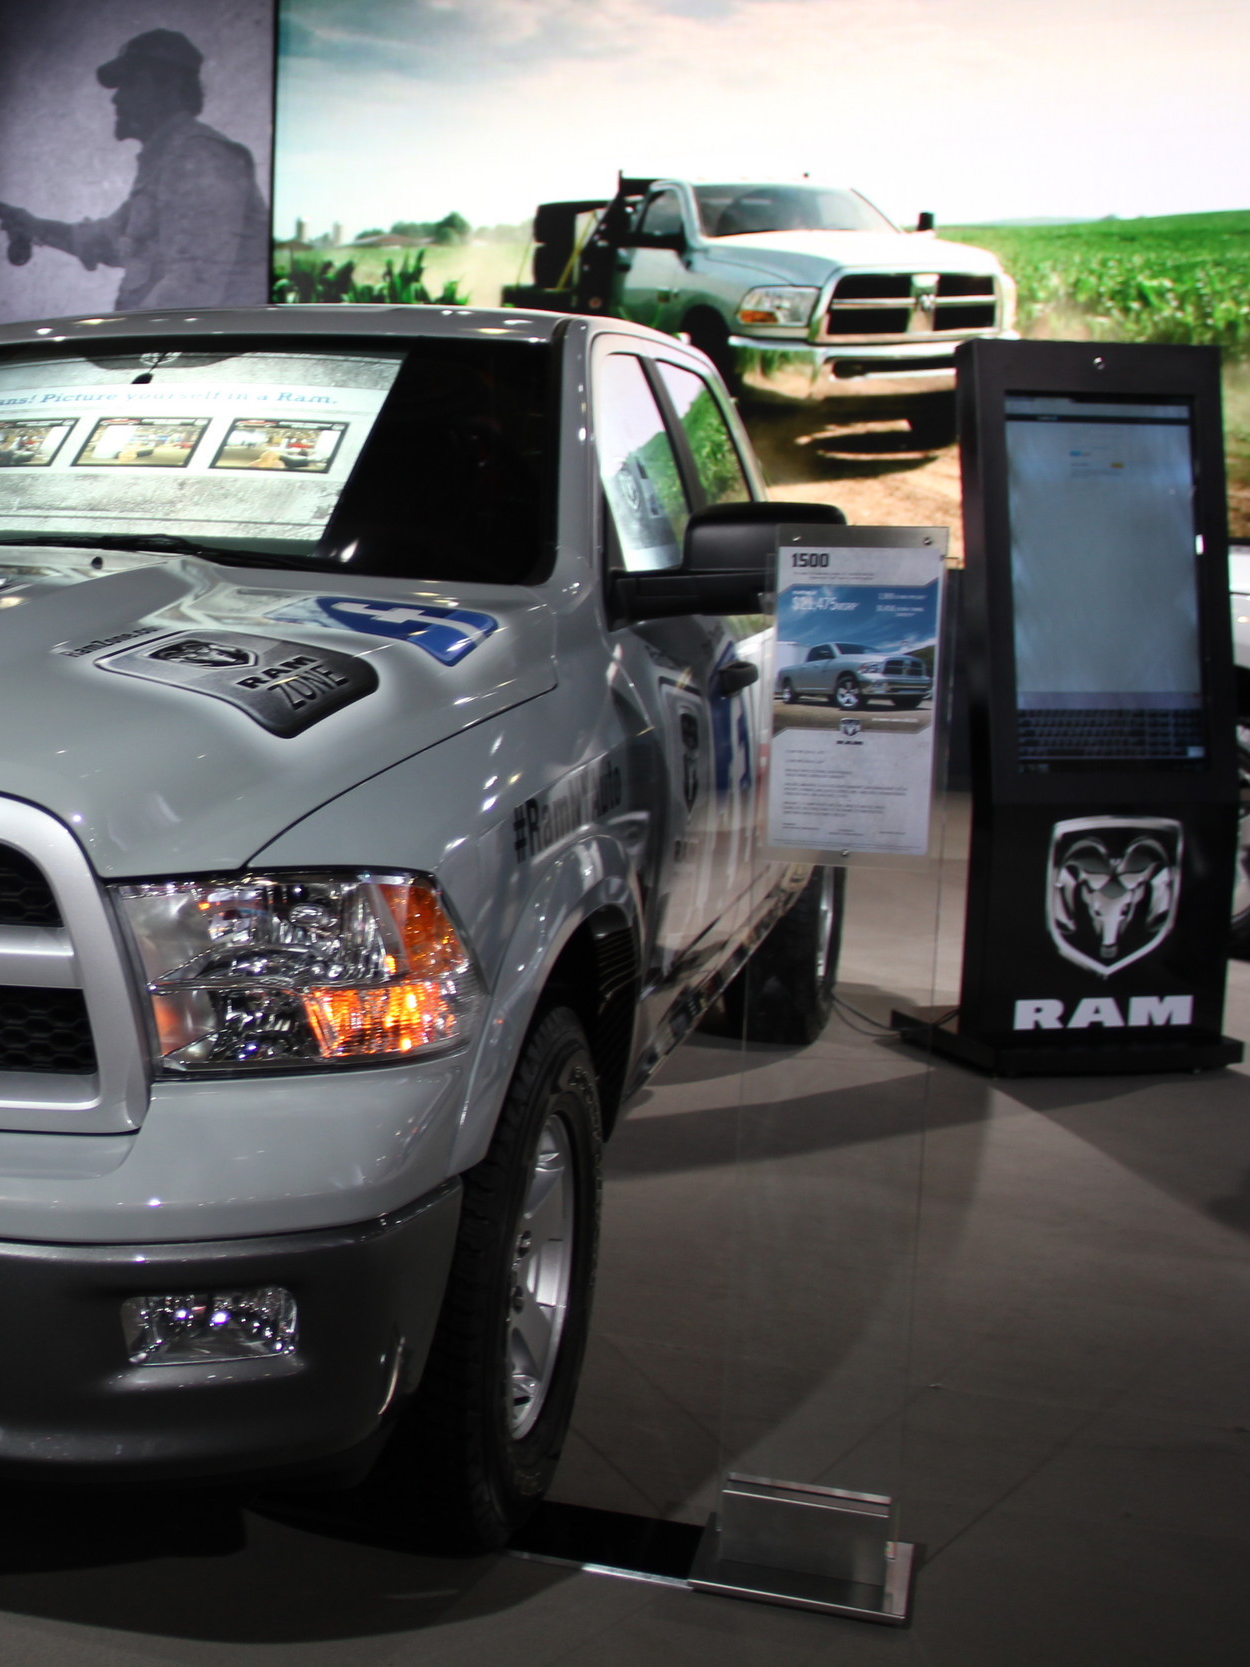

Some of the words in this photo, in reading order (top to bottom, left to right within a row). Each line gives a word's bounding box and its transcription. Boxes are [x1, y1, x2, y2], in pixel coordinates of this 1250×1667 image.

[41, 393, 118, 403] Picture
[792, 553, 829, 568] 1500
[236, 655, 319, 689] RAM
[267, 664, 349, 710] ZONE
[1013, 995, 1193, 1030] RAM
